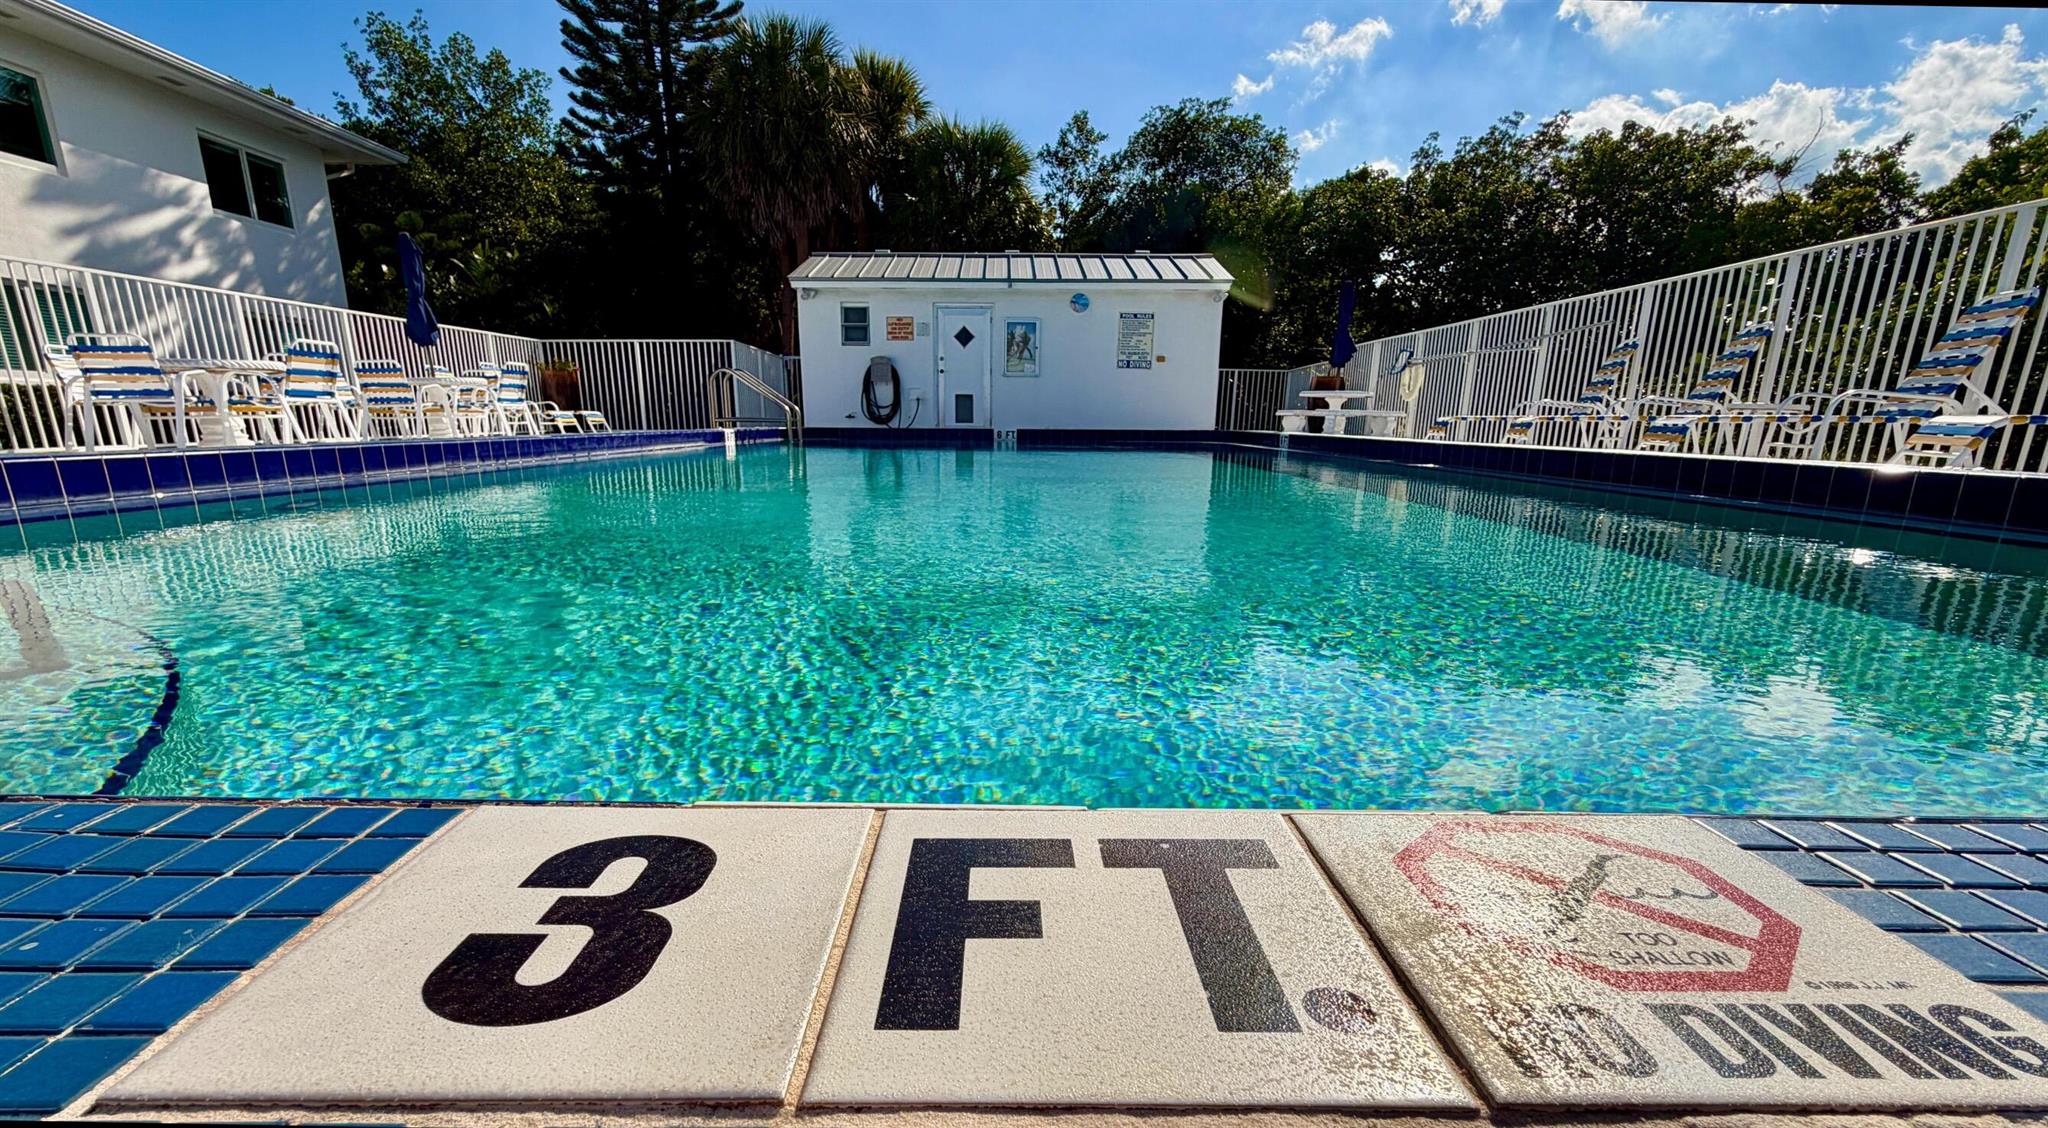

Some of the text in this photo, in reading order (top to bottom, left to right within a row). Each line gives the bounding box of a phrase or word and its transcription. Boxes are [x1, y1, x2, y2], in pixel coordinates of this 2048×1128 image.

[1129, 360, 1151, 368] DIVING
[997, 430, 1002, 439] 6
[421, 834, 1377, 1033] 3 FT.
[1617, 932, 1678, 946] TOO
[1608, 950, 1736, 966] SHALLOW
[1643, 1003, 2048, 1079] DIVING
